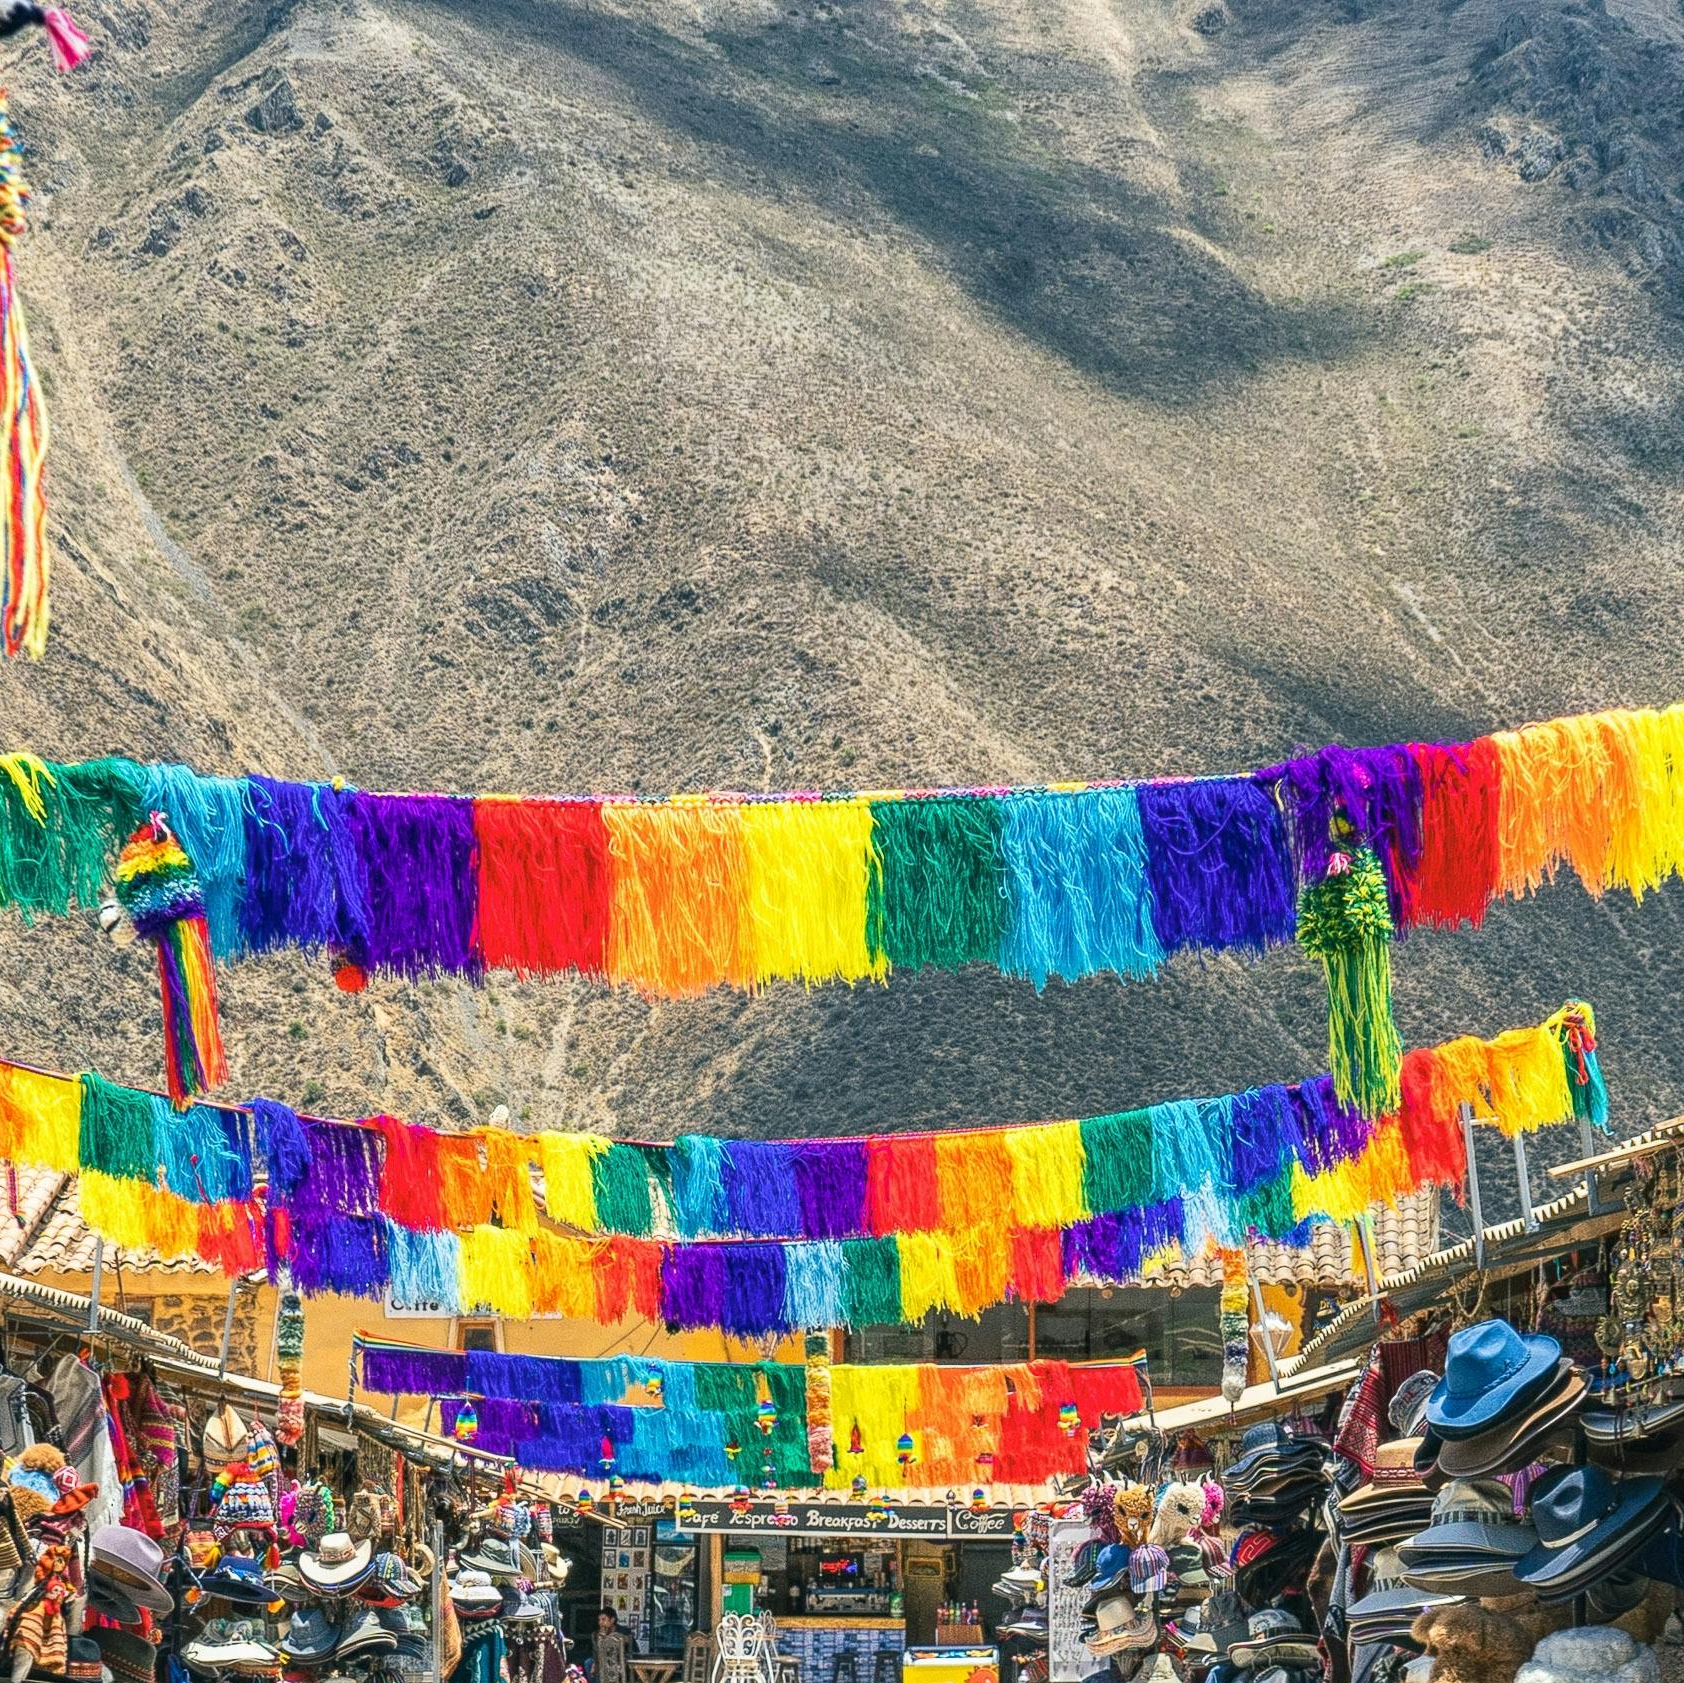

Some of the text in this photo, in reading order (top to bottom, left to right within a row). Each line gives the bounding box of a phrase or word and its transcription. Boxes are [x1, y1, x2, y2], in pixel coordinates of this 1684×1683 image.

[617, 1501, 666, 1517] Fresh Juice
[887, 1514, 947, 1531] Desserts
[955, 1510, 1008, 1533] Coffee
